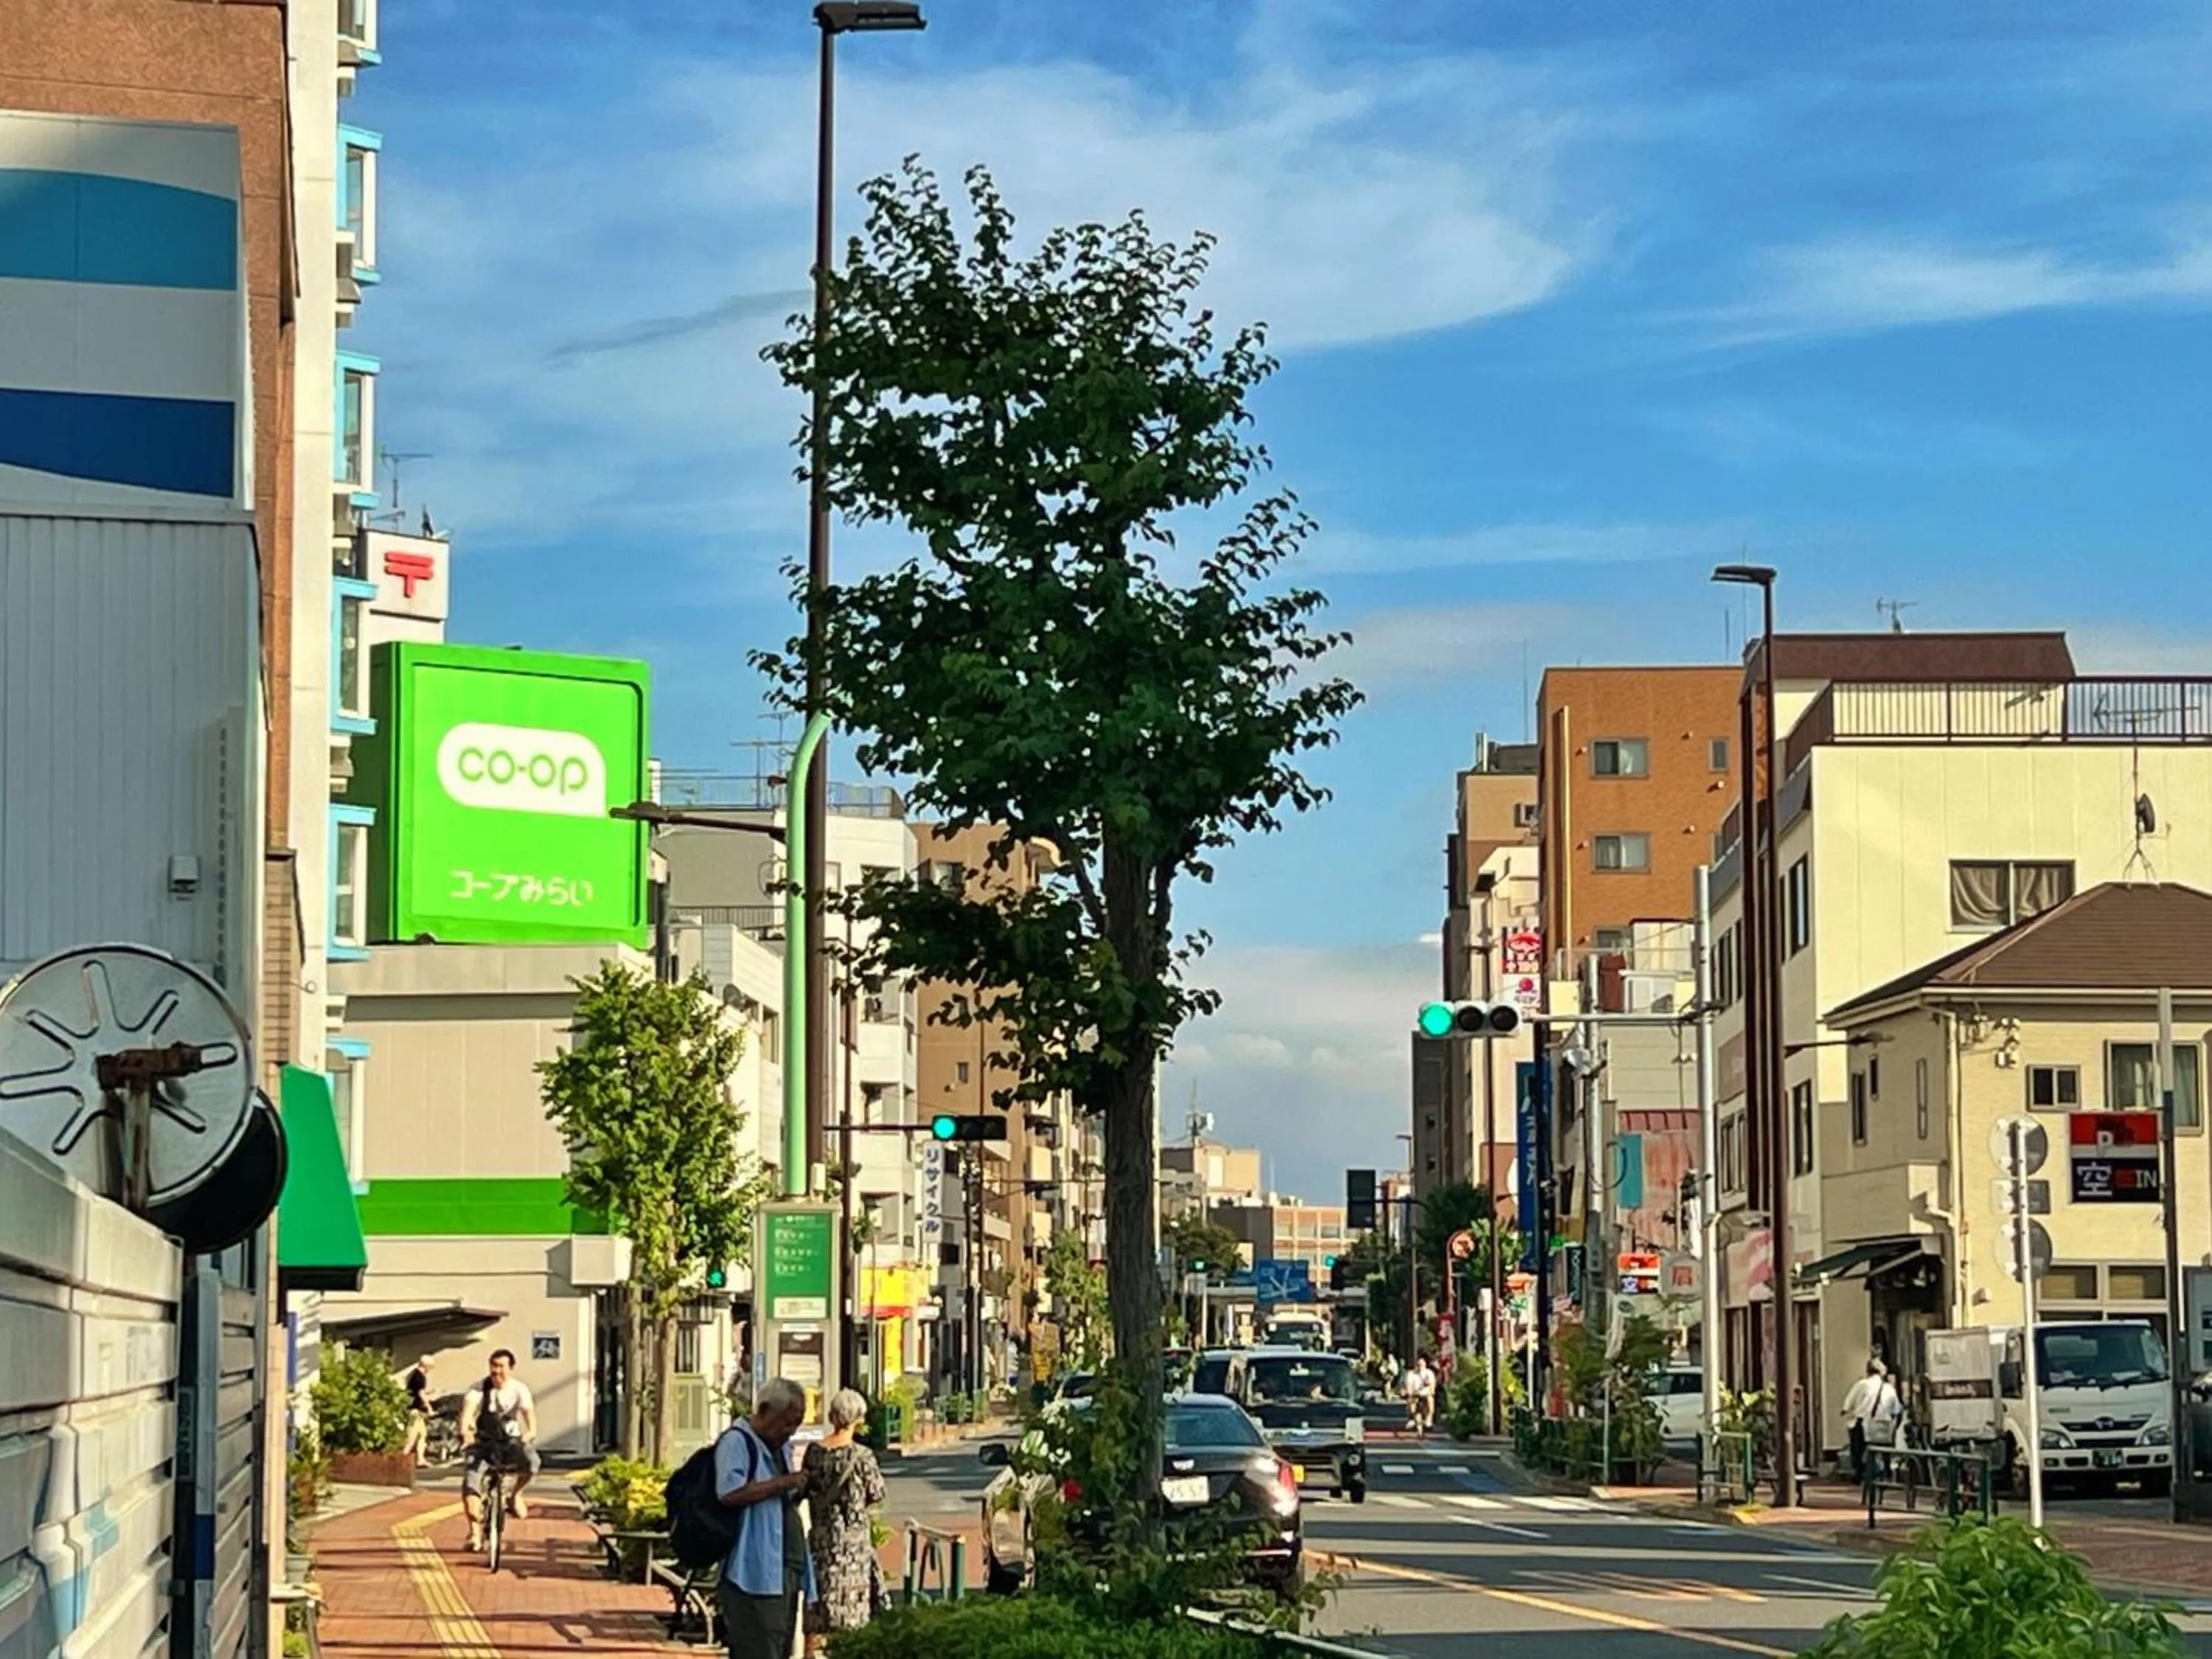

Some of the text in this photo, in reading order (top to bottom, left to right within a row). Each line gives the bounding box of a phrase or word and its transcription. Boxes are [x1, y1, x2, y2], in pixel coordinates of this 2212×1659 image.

[449, 870, 594, 908] コープみらい
[924, 1148, 941, 1234] リサイクル
[2076, 1161, 2157, 1196] 空 IN
